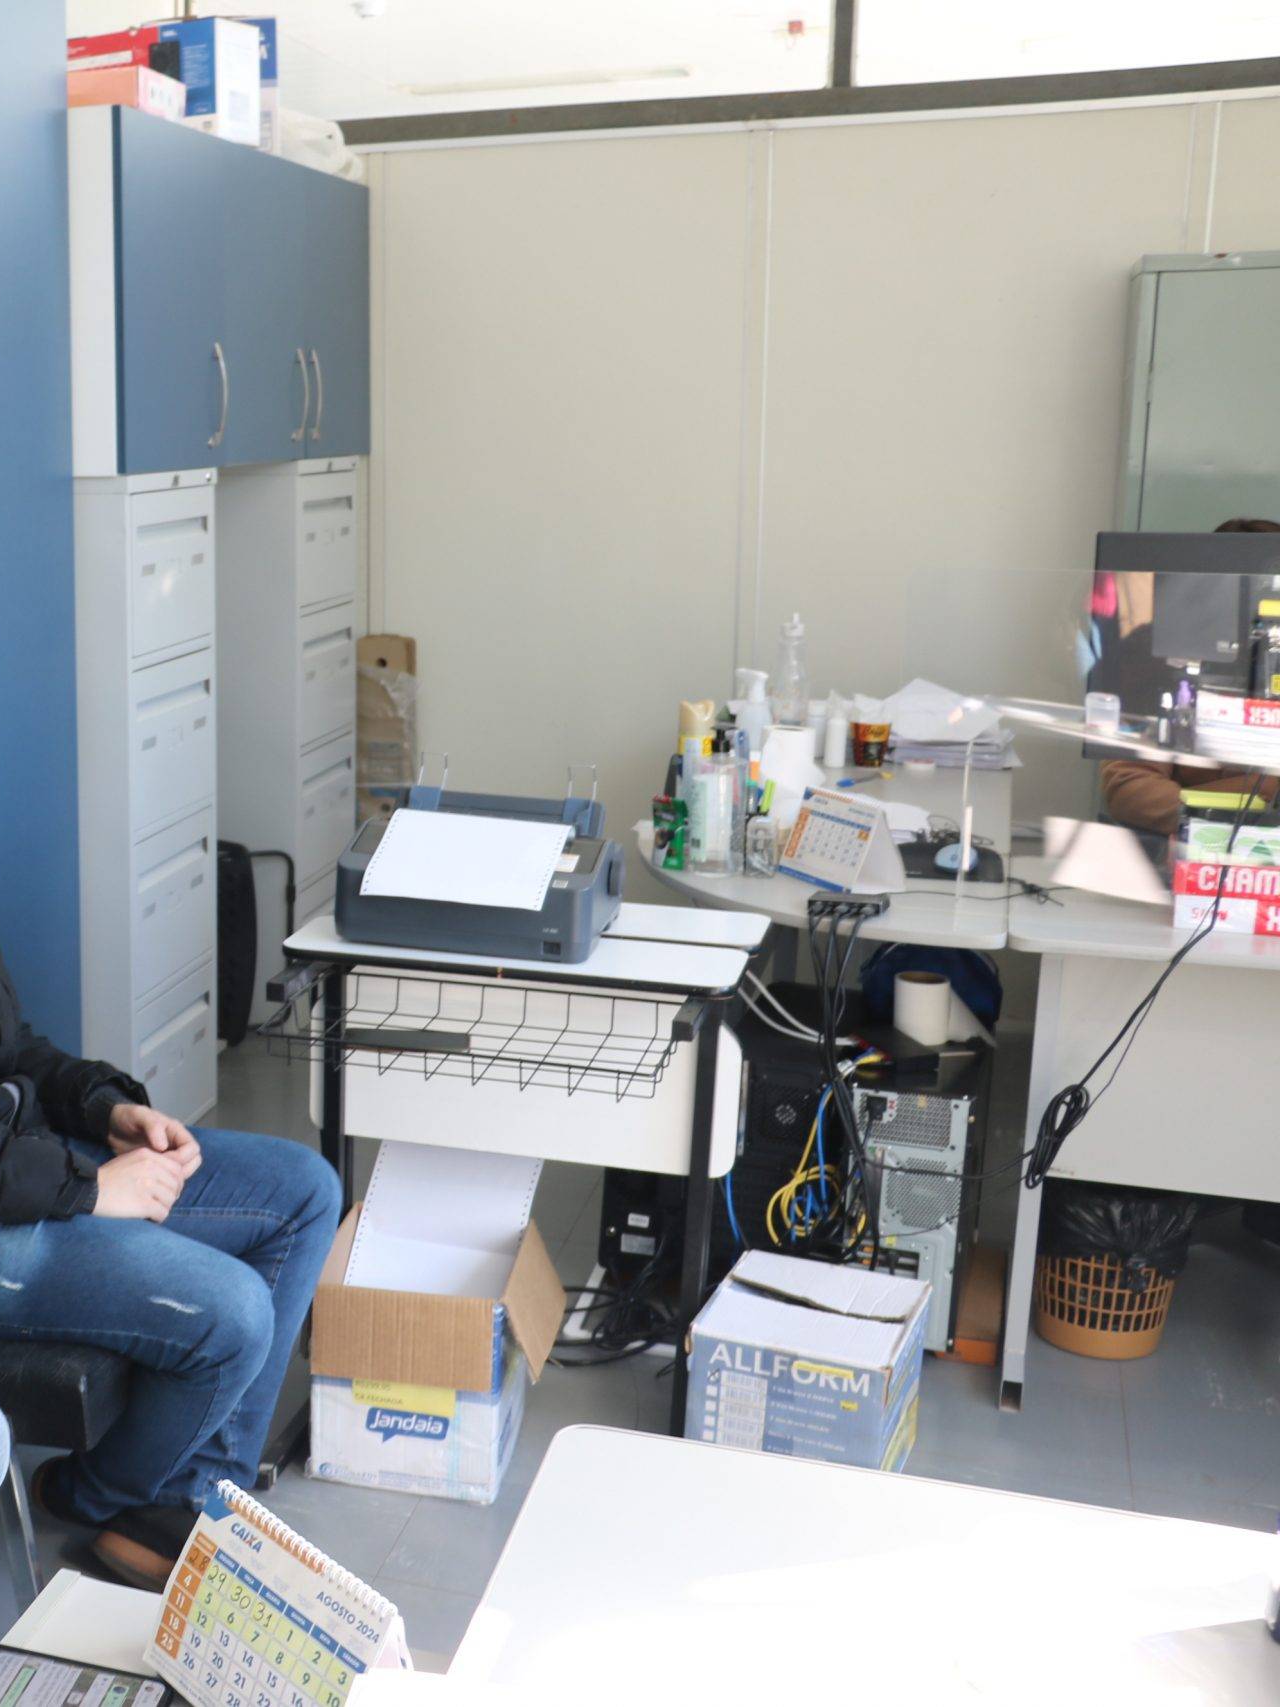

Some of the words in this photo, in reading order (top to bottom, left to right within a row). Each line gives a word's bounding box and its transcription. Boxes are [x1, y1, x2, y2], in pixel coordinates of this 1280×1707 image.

[230, 1522, 263, 1553] CAIXA
[207, 1564, 227, 1592] 29
[230, 1586, 251, 1609] 30
[253, 1602, 272, 1628] 31
[316, 1591, 356, 1624] AGOSTO
[356, 1620, 380, 1643] 2024
[184, 1573, 193, 1587] 4
[204, 1591, 213, 1604] 5
[227, 1612, 235, 1624] 6
[250, 1631, 260, 1642] 7
[275, 1651, 284, 1664] 8
[302, 1672, 311, 1685] 9
[326, 1692, 340, 1707] 10
[190, 1633, 201, 1648] 19
[212, 1651, 223, 1669] 20
[233, 1672, 246, 1689] 21
[196, 1610, 207, 1628] 12
[219, 1630, 230, 1647] 13
[242, 1650, 254, 1667] 14
[266, 1670, 278, 1688] 15
[286, 1629, 293, 1642] 1
[312, 1651, 321, 1664] 2
[338, 1671, 347, 1685] 3
[183, 1652, 195, 1670] 26
[206, 1672, 218, 1688] 27
